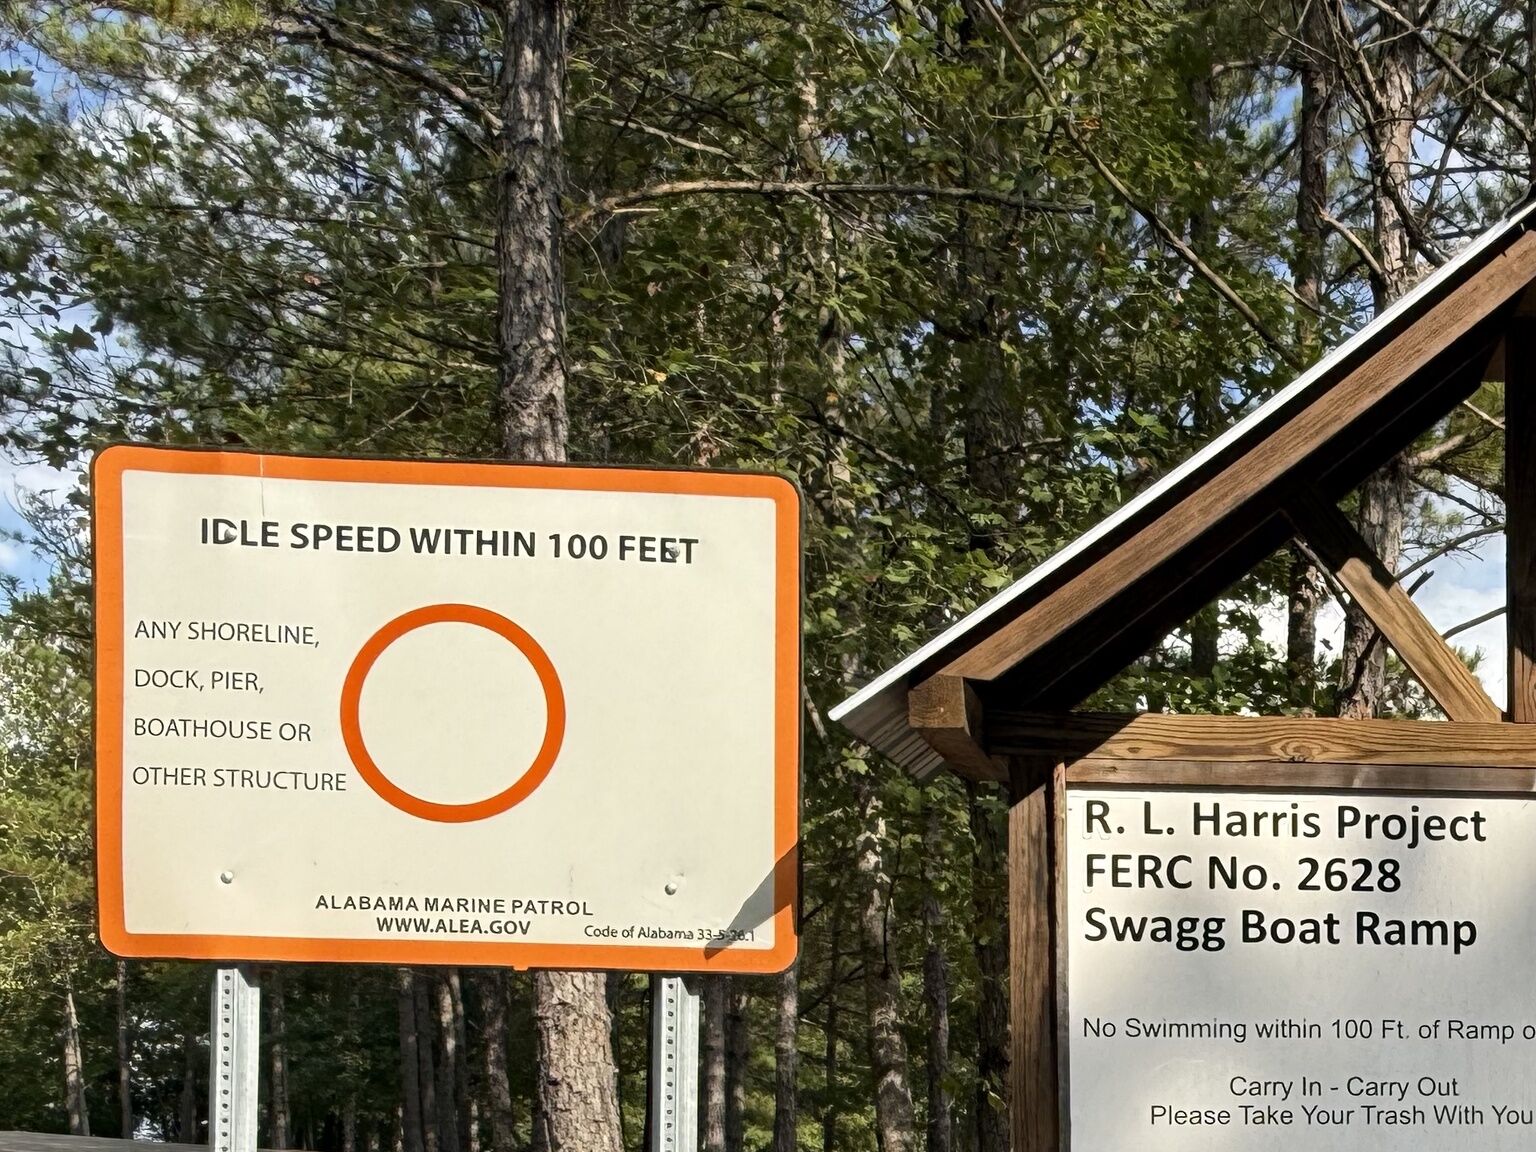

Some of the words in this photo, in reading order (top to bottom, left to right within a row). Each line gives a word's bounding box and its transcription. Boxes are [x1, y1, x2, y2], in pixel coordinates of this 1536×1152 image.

[202, 518, 279, 547] IDLE
[291, 524, 400, 552] SPEED
[410, 528, 535, 557] WITHIN
[549, 534, 607, 560] 100
[620, 536, 698, 563] FEET
[135, 621, 181, 639] ANY
[188, 622, 319, 648] SHORELINE,
[136, 669, 204, 691] DOCK,
[212, 671, 263, 693] PIER,
[135, 718, 271, 739] BOATHOUSE
[279, 723, 311, 741] OR
[133, 767, 206, 786] OTHER
[214, 769, 346, 791] STRUCTURE
[1087, 800, 1124, 834] R.
[1144, 801, 1174, 835] L.
[1194, 803, 1320, 838] Harris
[1338, 806, 1486, 849] Project
[1087, 854, 1192, 889] FERC
[1209, 856, 1280, 890] No.
[1298, 858, 1401, 892] 2628
[316, 895, 418, 911] ALABAMA
[423, 897, 507, 916] MARINE
[512, 900, 593, 915] PATROL
[377, 917, 530, 935] WWW.ALEA.GOV
[583, 924, 617, 941] Code
[619, 924, 635, 942] of
[636, 926, 694, 943] Alabama
[1085, 908, 1225, 951] Swagg
[1243, 910, 1340, 944] Boat
[1357, 912, 1476, 954] Ramp
[1084, 1018, 1116, 1037] No
[1126, 1018, 1246, 1043] Swimming
[1255, 1019, 1321, 1038] within
[1332, 1019, 1372, 1038] 100
[1383, 1020, 1409, 1038] Ft.
[1419, 1020, 1440, 1038] of
[1449, 1020, 1514, 1044] Ramp
[1230, 1077, 1293, 1101] Carry
[1303, 1077, 1321, 1096] In
[1347, 1077, 1409, 1101] Carry
[1418, 1077, 1459, 1096] Out
[1152, 1105, 1230, 1124] Please
[1239, 1106, 1293, 1125] Take
[1302, 1105, 1354, 1124] Your
[1361, 1103, 1426, 1125] Trash
[1434, 1105, 1483, 1124] With
[1492, 1105, 1532, 1124] You
